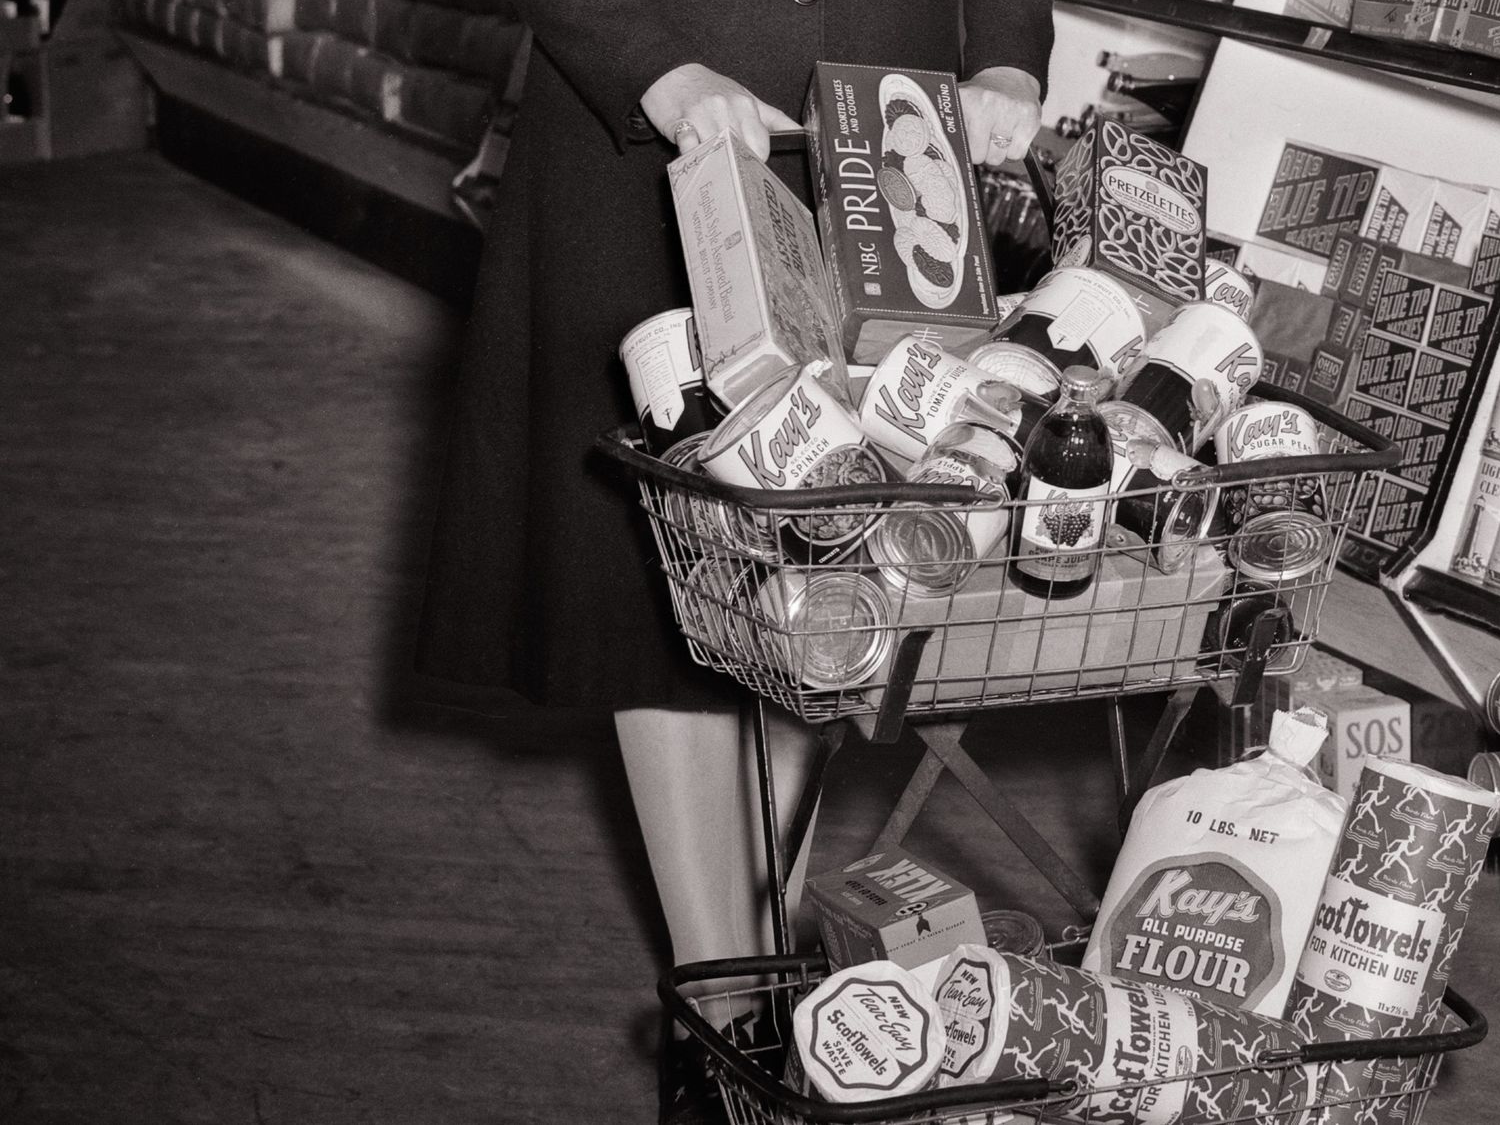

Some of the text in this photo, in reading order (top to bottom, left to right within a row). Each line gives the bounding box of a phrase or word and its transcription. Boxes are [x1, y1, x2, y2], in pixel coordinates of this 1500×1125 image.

[833, 79, 848, 135] ASSORTED CAKES
[847, 84, 861, 133] AND COOKIES
[940, 83, 956, 133] ONE POUND
[834, 138, 883, 232] PRIDE
[1108, 174, 1196, 226] PRETZELETTES
[1260, 171, 1375, 233] BLUE TIP
[858, 243, 881, 276] NBC
[1428, 306, 1486, 338] BLUE TIP
[875, 343, 942, 446] Kay's
[927, 365, 967, 419] TOMATO JUICE
[738, 386, 822, 490] Kay's
[790, 439, 830, 478] SPINACH
[1226, 409, 1300, 459] Kay's
[1250, 439, 1285, 451] SUGAR
[1186, 810, 1279, 845] 10 LBS. NET
[1136, 869, 1262, 926] Kay's
[1142, 917, 1245, 954] ALL PURPOSE
[1315, 896, 1433, 963] cotTowels
[961, 969, 978, 985] NEW
[1116, 934, 1251, 998] FLOUR
[1309, 935, 1419, 986] FOR KITCHEN USE
[853, 988, 916, 1051] Tear-Easy
[888, 996, 911, 1020] NEW
[822, 1040, 846, 1075] WASTE
[827, 1009, 887, 1076] ScotTowels
[833, 1040, 853, 1067] SAVE
